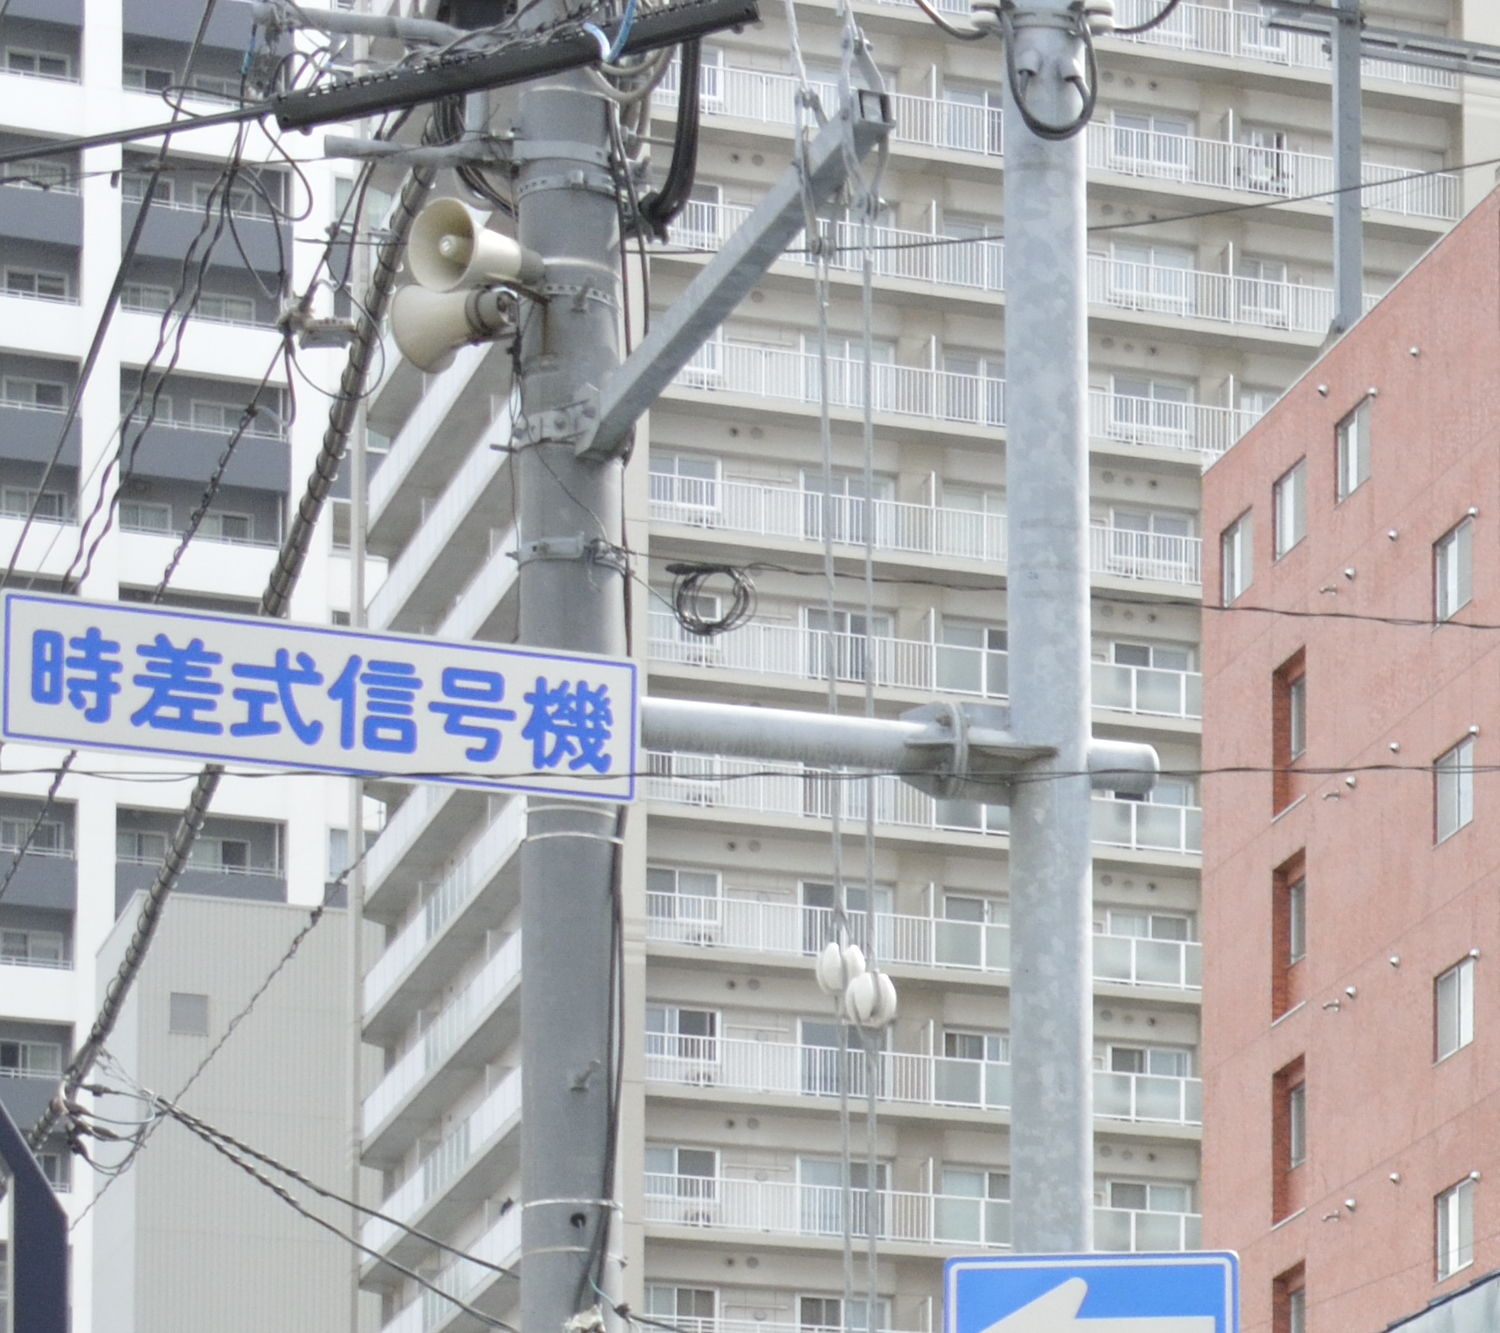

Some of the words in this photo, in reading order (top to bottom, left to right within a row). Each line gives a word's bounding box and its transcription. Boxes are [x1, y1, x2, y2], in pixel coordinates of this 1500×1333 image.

[29, 625, 614, 774] 時差式信号機
